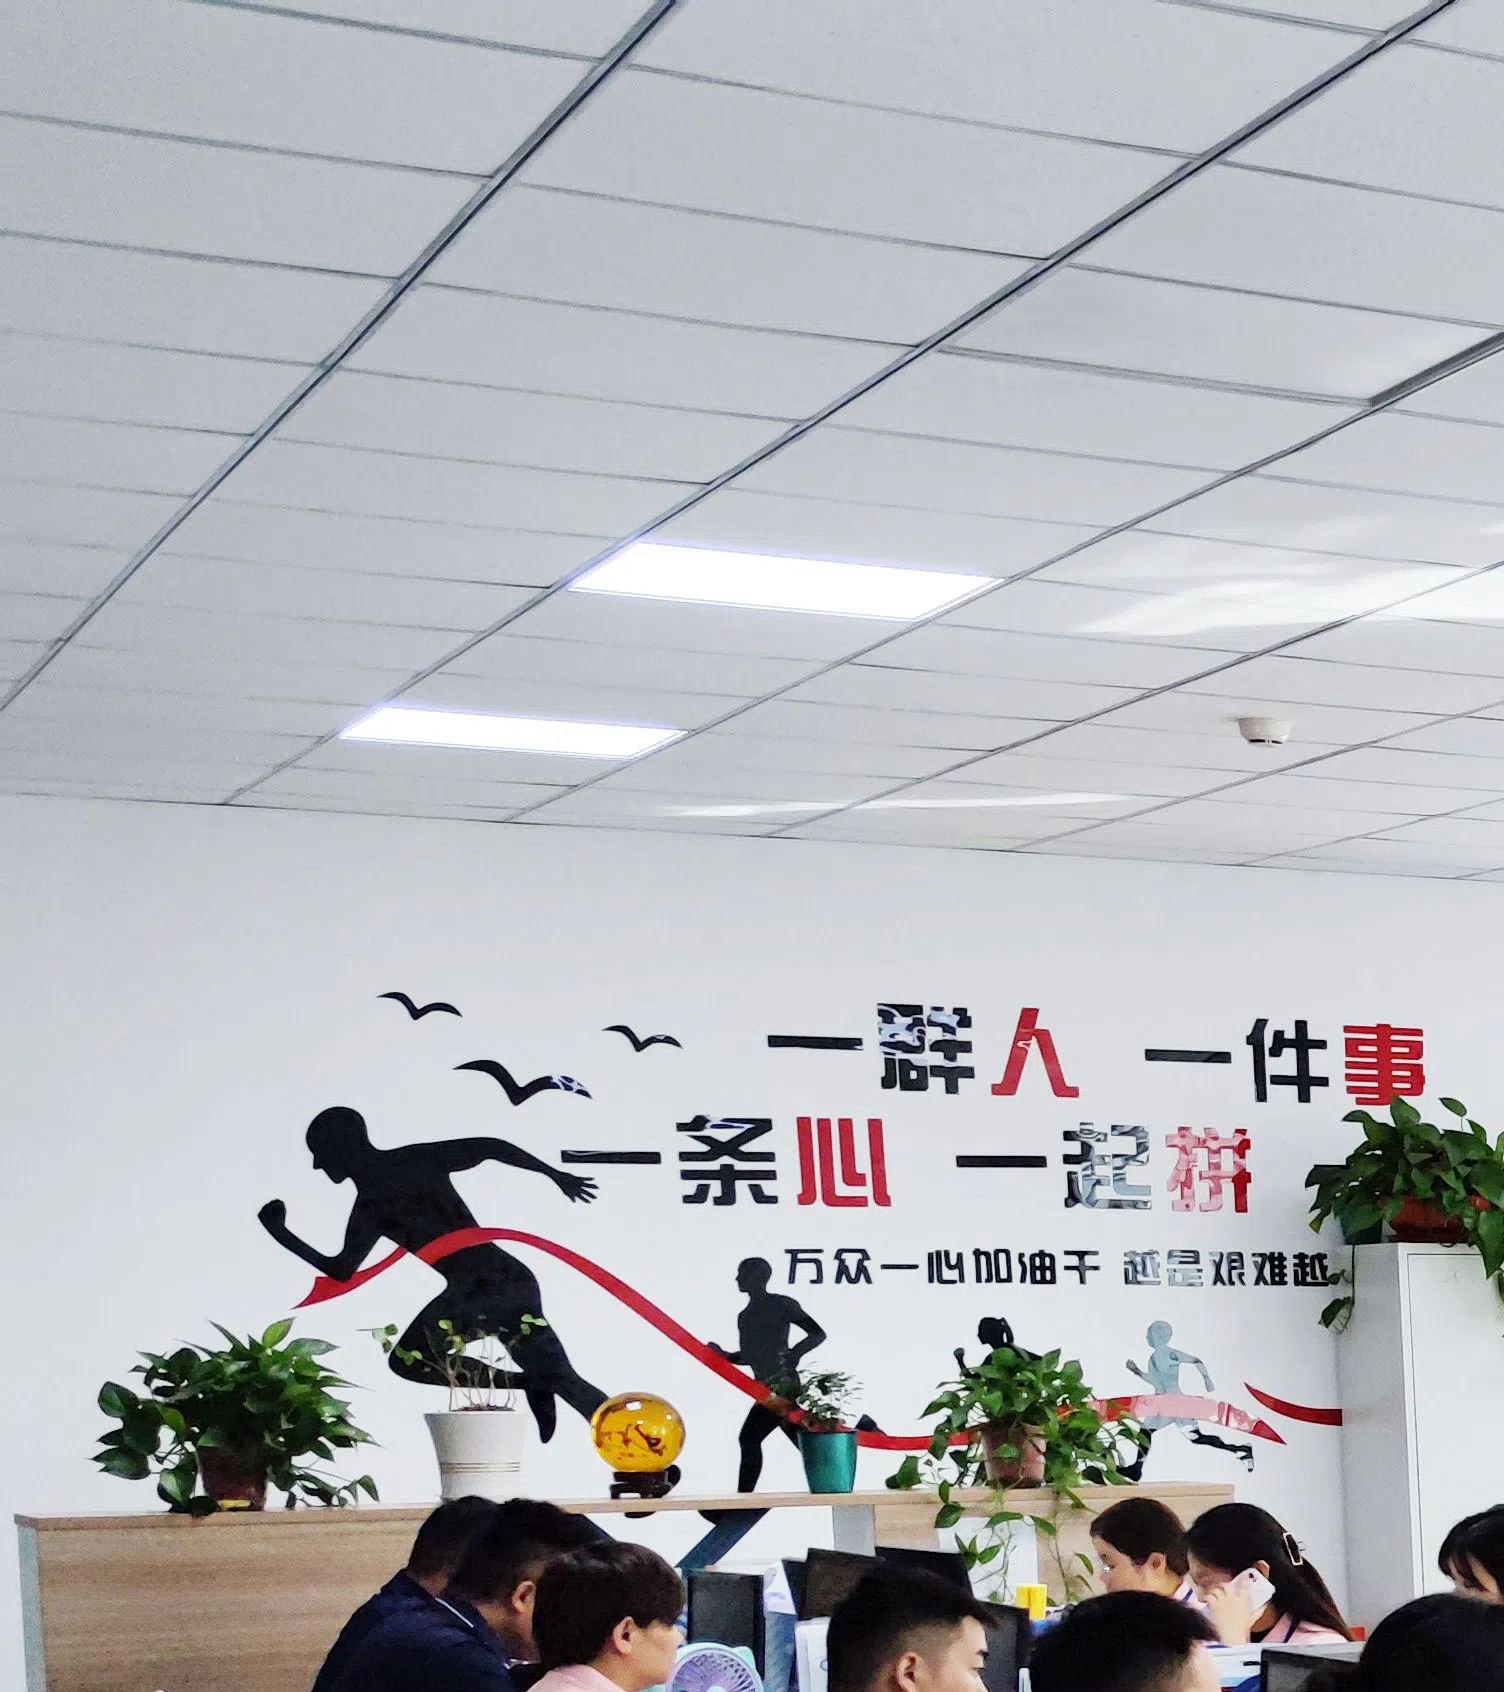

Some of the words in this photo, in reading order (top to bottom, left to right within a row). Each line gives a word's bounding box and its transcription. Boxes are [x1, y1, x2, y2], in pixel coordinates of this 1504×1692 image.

[767, 1003, 1080, 1098] 一群人
[1144, 1018, 1425, 1105] 一件事
[561, 1115, 892, 1207] 一条心
[956, 1122, 1251, 1213] 一起拼
[784, 1248, 1101, 1285] 万众一心加油干
